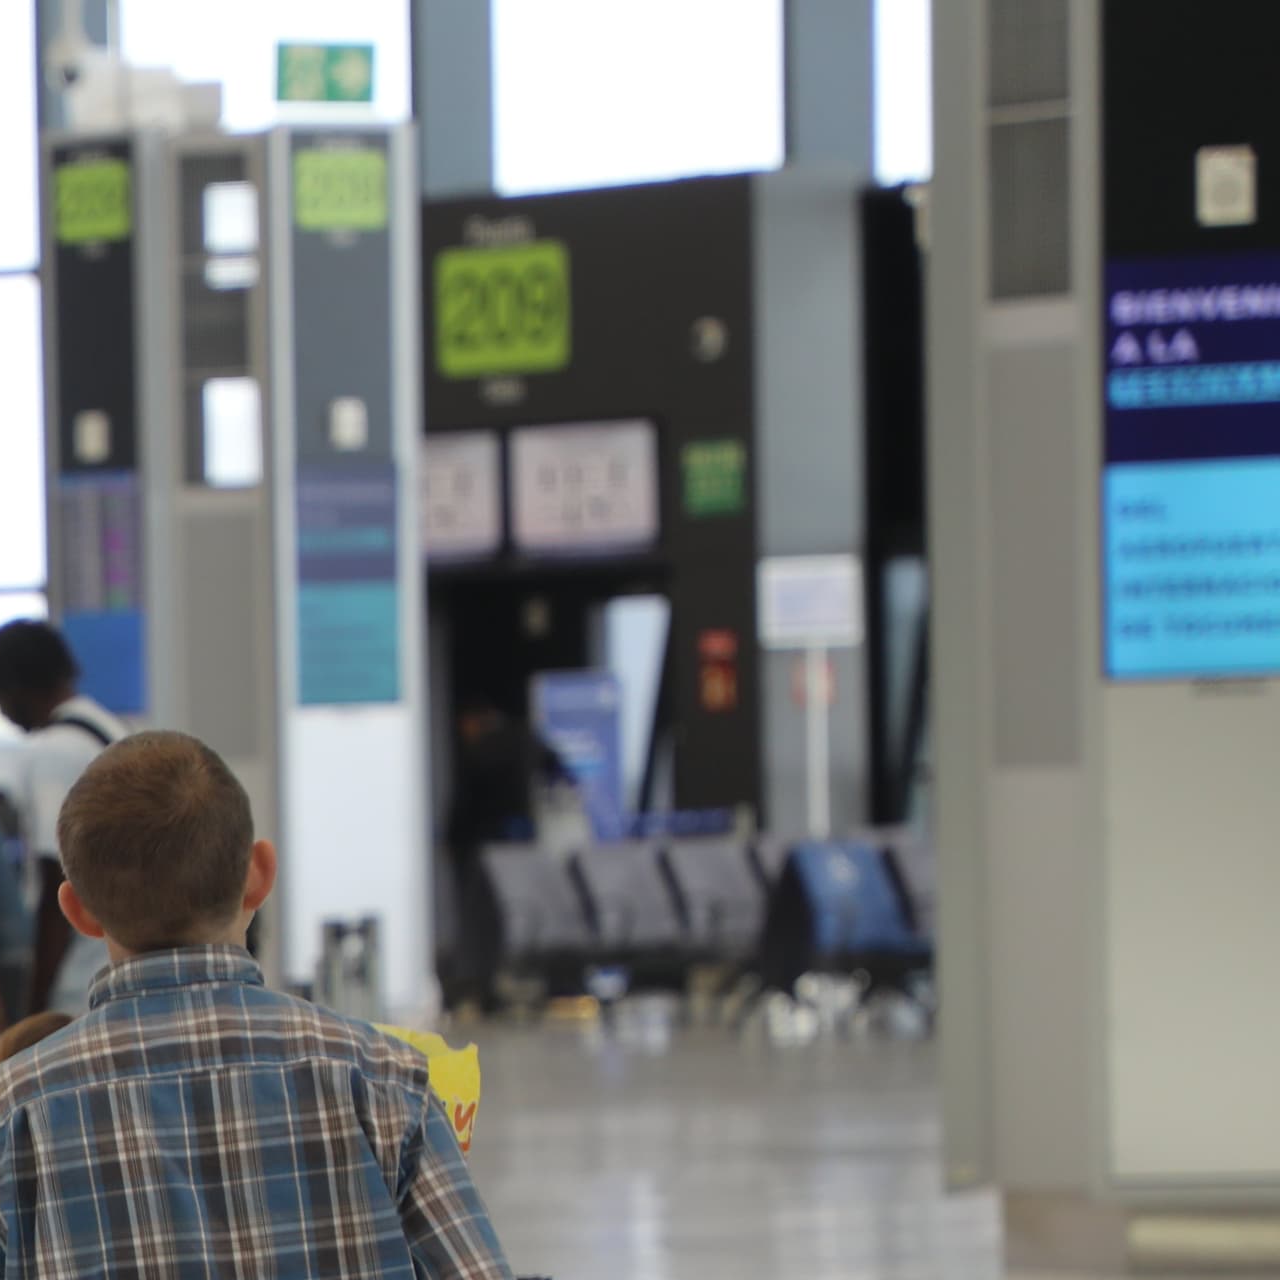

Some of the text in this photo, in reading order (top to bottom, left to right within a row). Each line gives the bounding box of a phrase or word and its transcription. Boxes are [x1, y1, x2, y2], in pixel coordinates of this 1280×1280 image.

[449, 264, 563, 350] 209
[1111, 328, 1199, 366] A LA
